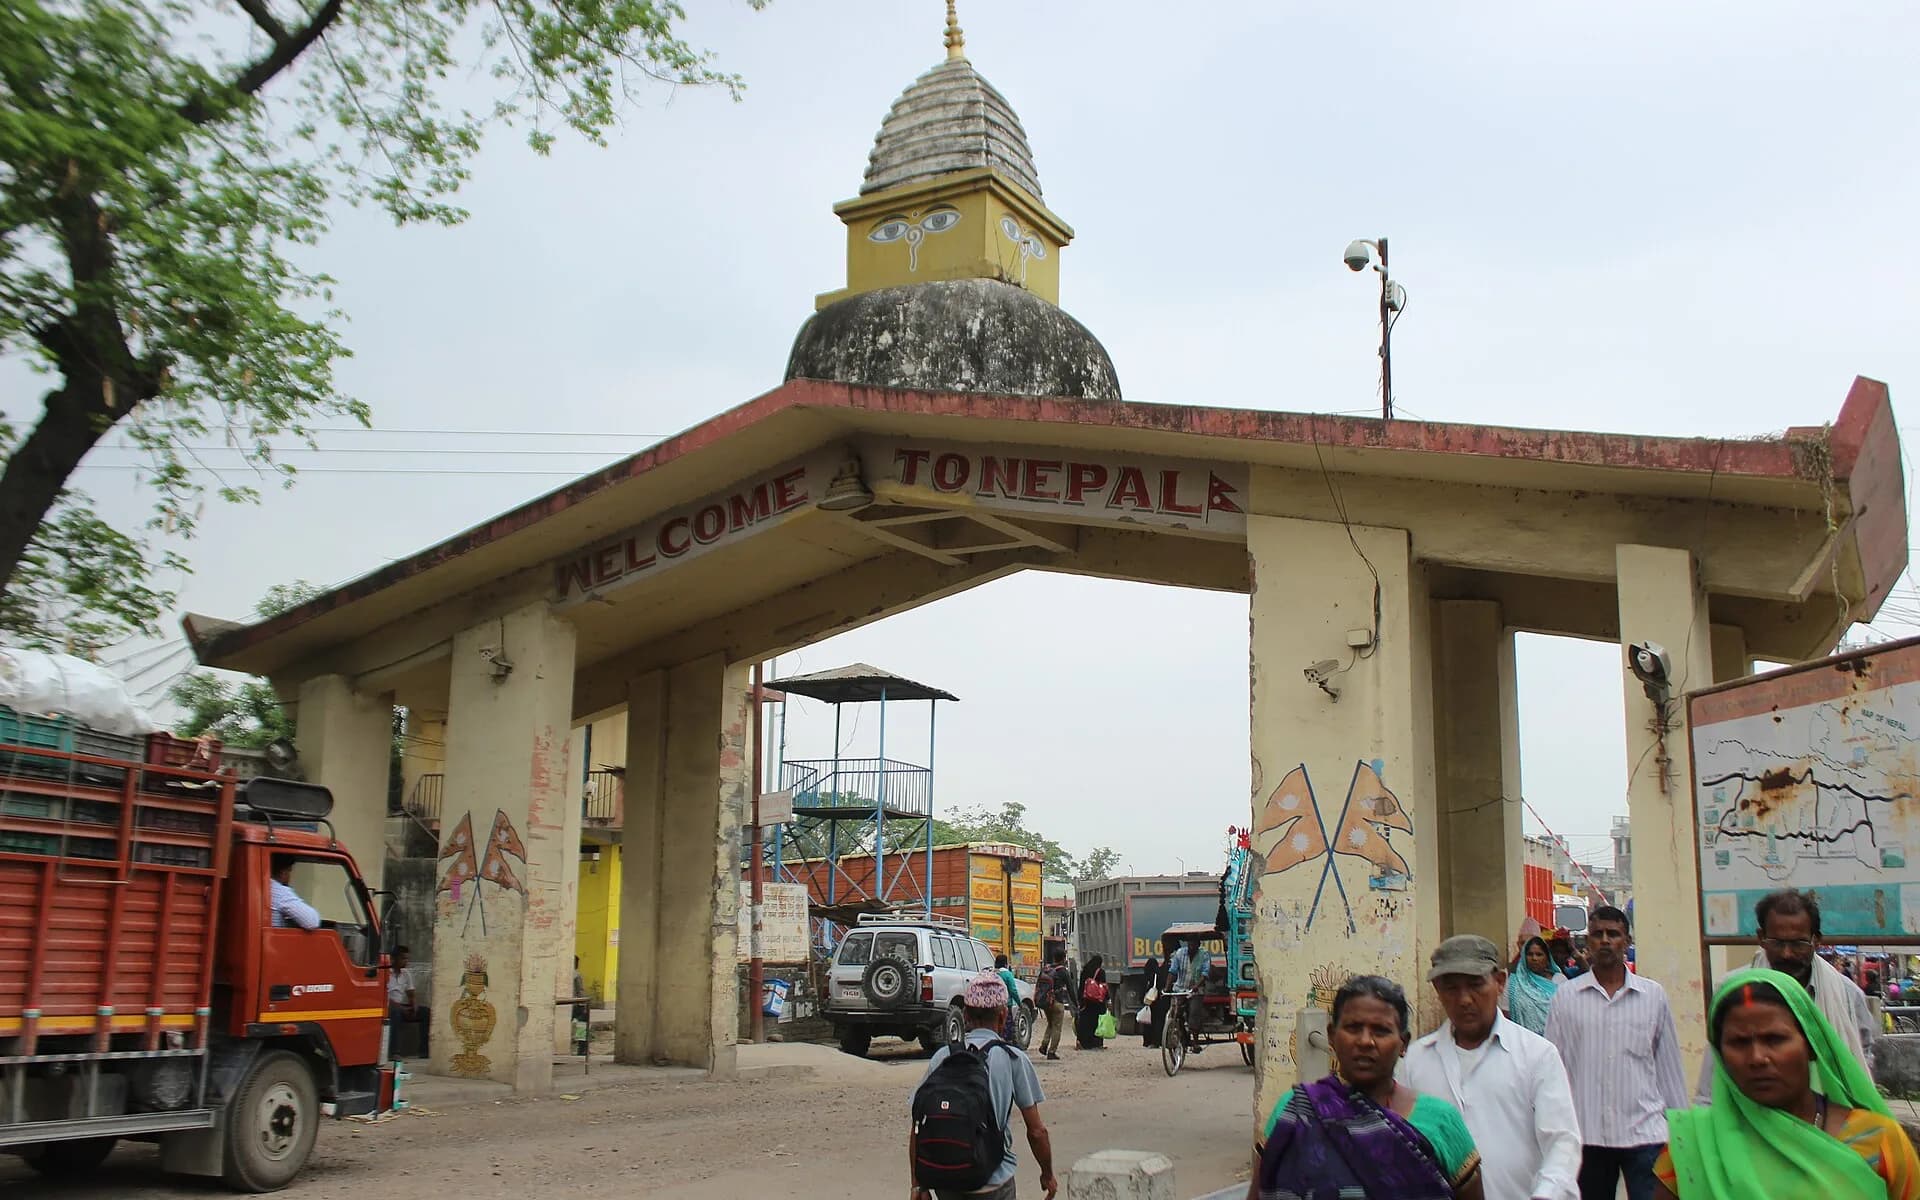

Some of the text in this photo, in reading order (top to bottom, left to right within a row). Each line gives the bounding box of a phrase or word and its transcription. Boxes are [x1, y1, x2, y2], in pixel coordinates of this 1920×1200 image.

[555, 448, 1202, 602] WELCOME TO NEPAL
[1875, 713, 1884, 722] OF
[1885, 716, 1907, 732] NEPAL
[1134, 938, 1164, 957] BLO
